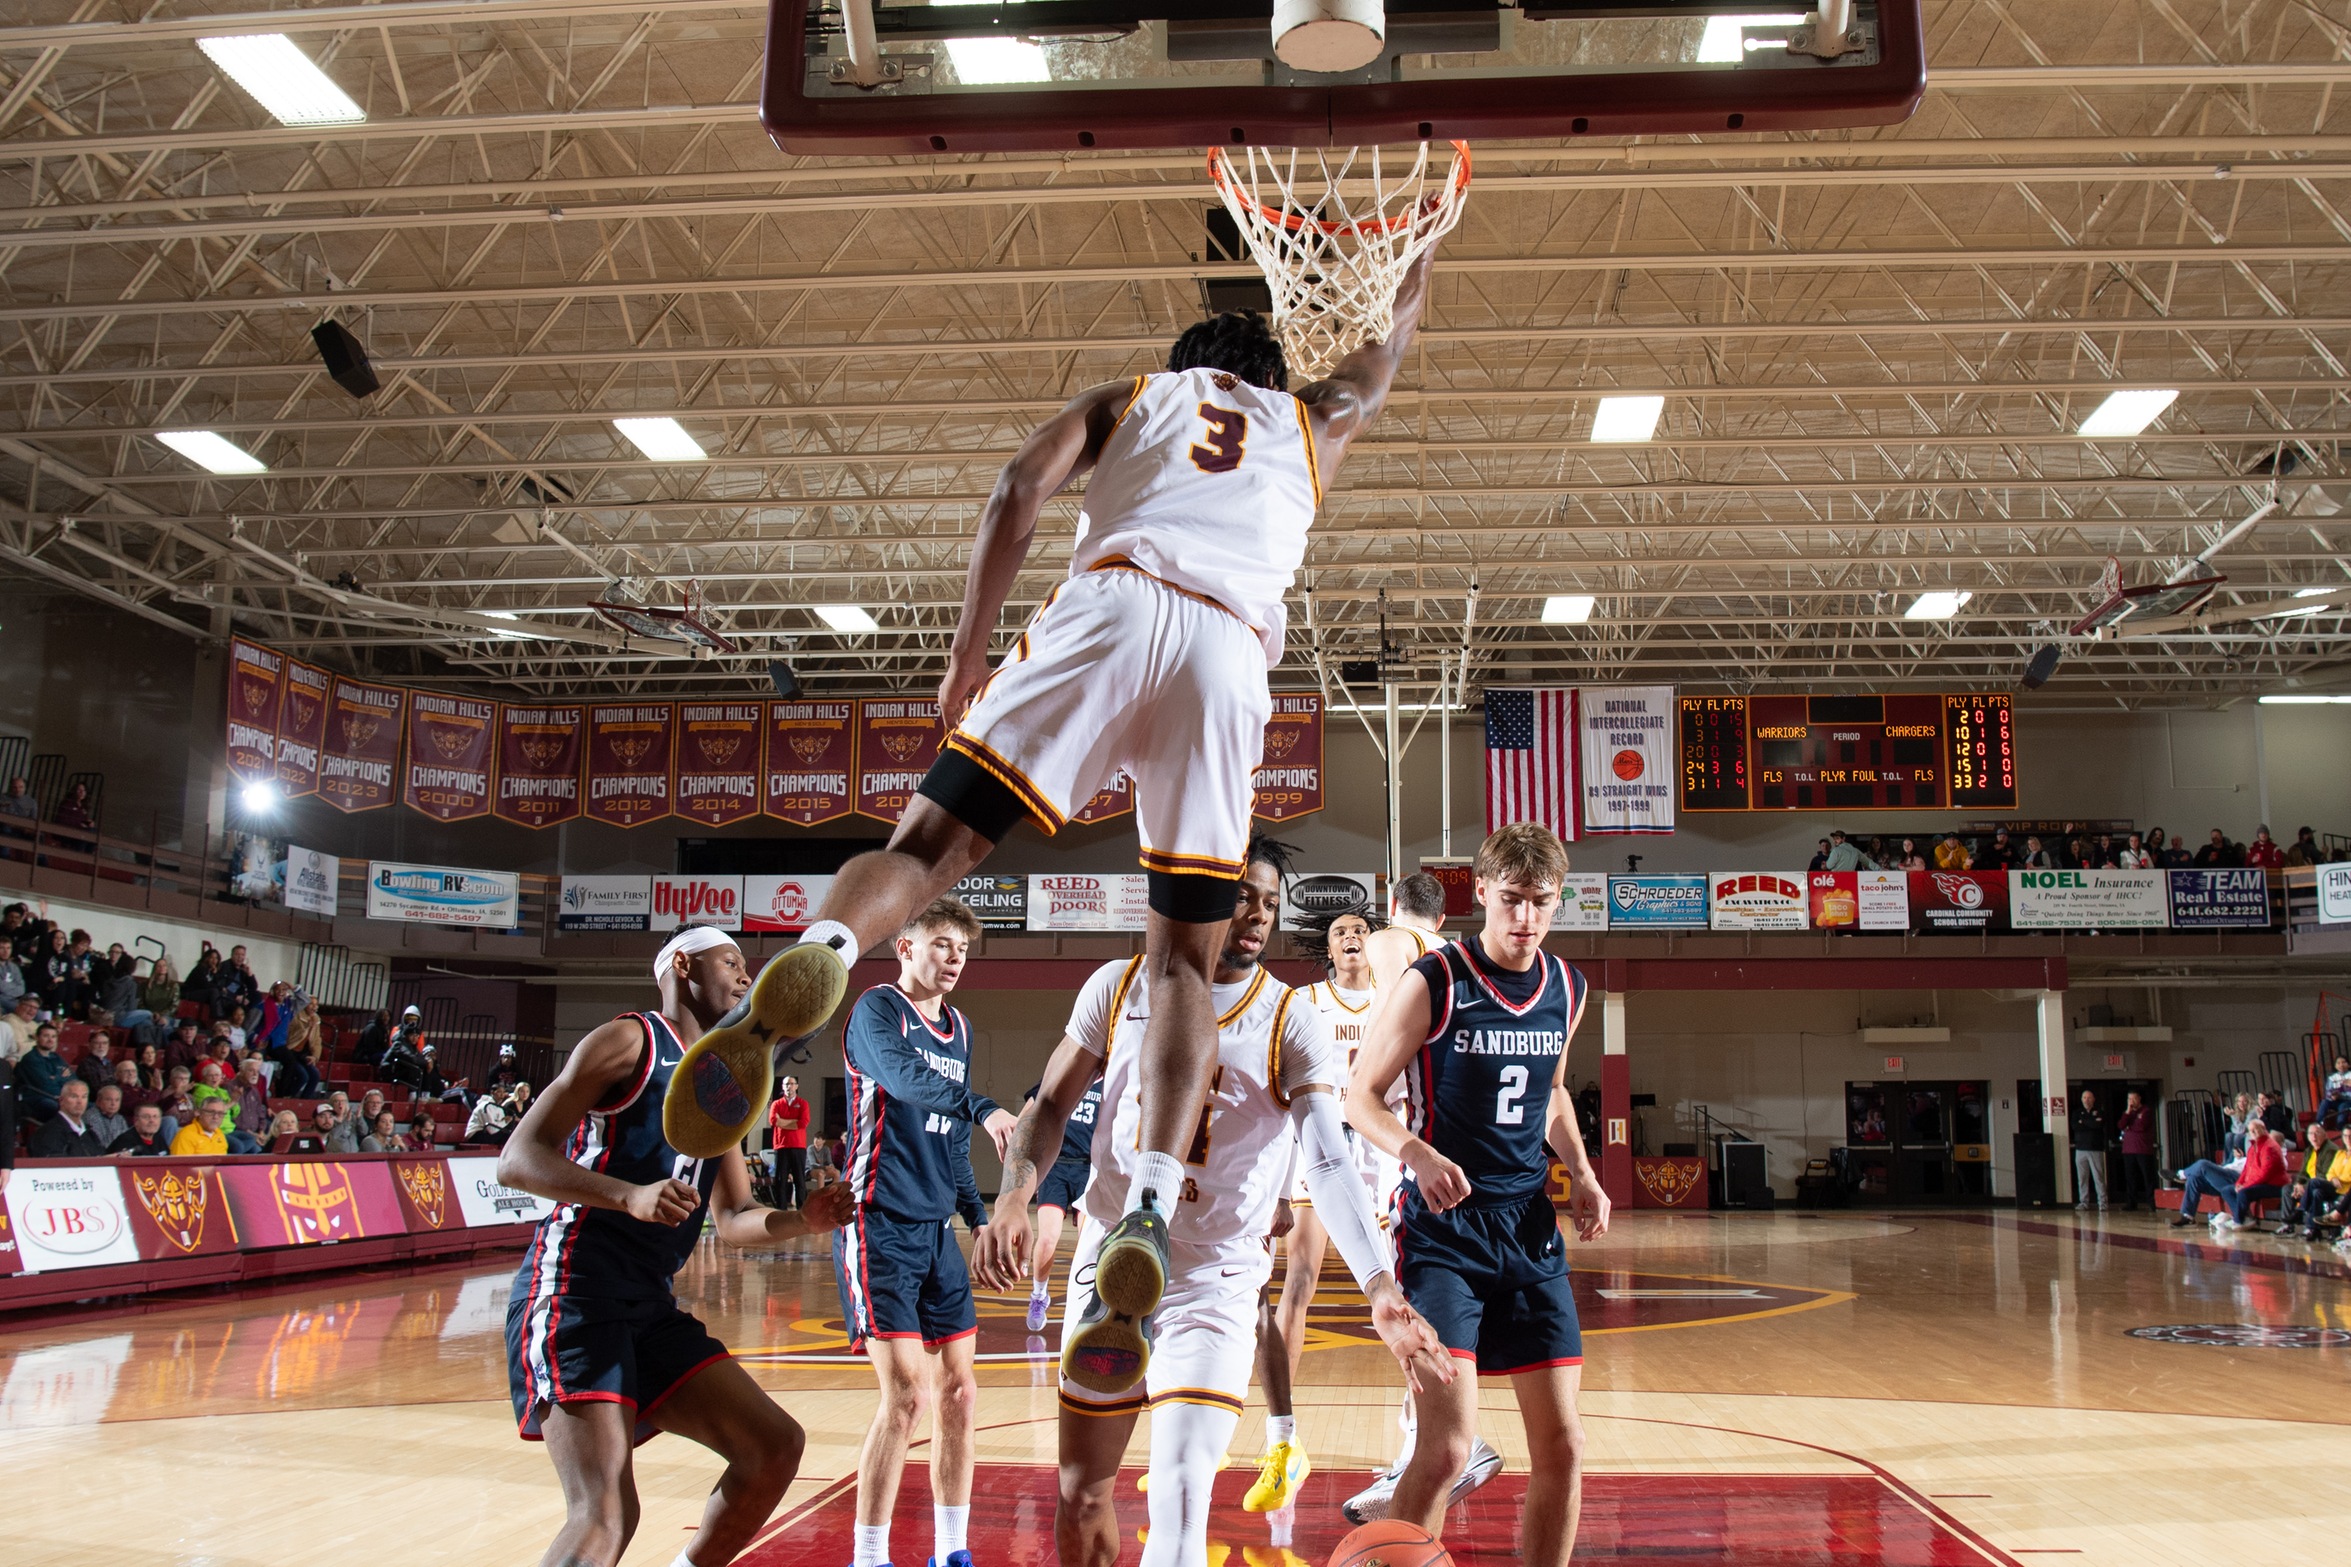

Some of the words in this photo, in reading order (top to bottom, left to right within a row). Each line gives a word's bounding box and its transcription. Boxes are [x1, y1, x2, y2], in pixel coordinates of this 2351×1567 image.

[1188, 401, 1248, 474] 3
[261, 653, 281, 673] HILLS
[337, 683, 362, 704] INDIAN
[364, 690, 399, 709] HILLS
[1948, 697, 1966, 708] PLY
[1973, 697, 1985, 708] FL
[1989, 696, 2009, 707] PTS
[416, 695, 456, 715] INDIAN
[459, 702, 492, 720] HILLS
[774, 705, 813, 720] INDIAN
[816, 704, 849, 719] HILLS
[865, 704, 905, 718] INDIAN
[908, 703, 941, 717] HILLS
[1283, 698, 1317, 713] HILLS
[1605, 700, 1647, 713] NATIONAL
[1683, 700, 1701, 711] PLY
[1707, 700, 1720, 711] FL
[1723, 700, 1744, 710] PTS
[507, 709, 547, 724] INDIAN
[549, 710, 580, 724] HILLS
[595, 708, 633, 723] INDIAN
[636, 707, 669, 722] HILLS
[684, 707, 723, 721] INDIAN
[726, 706, 758, 721] HILLS
[1695, 714, 1703, 726] 0
[1710, 714, 1718, 726] 0
[1960, 710, 1968, 724] 2
[1975, 710, 1984, 723] 0
[2000, 709, 2008, 723] 0
[1589, 716, 1664, 729] INTERCOLLEGIATE
[1696, 729, 1704, 742] 3
[1735, 729, 1743, 741] 9
[1757, 726, 1807, 739] WARRIORS
[1833, 733, 1860, 741] PERIOD
[1885, 726, 1936, 737] CHARGERS
[1956, 726, 1970, 740] 10
[2001, 726, 2009, 739] 6
[229, 723, 274, 759] CHAMPIONS
[1611, 733, 1644, 746] RECORD
[1686, 745, 1704, 758] 20
[1711, 745, 1719, 758] 0
[1736, 745, 1744, 757] 3
[1957, 742, 1970, 756] 12
[1977, 742, 1986, 755] 0
[2001, 742, 2010, 755] 6
[321, 754, 392, 787] CHAMPIONS
[1686, 762, 1704, 774] 24
[1712, 761, 1719, 774] 3
[1735, 761, 1744, 774] 6
[1957, 758, 1971, 772] 15
[2002, 758, 2011, 772] 0
[412, 766, 486, 796] CHAMPIONS
[1763, 771, 1783, 783] FLS
[1795, 773, 1816, 782] T.O.L.
[1820, 770, 1846, 782] PLYR
[1852, 770, 1878, 782] FOUL
[1883, 772, 1904, 781] T.O.L.
[1914, 769, 1934, 781] FLS
[1954, 774, 1972, 789] 33
[1978, 774, 1987, 788] 2
[2003, 774, 2012, 788] 0
[326, 780, 378, 797] 2023
[501, 777, 576, 799] CHAMPIONS
[591, 776, 666, 799] CHAMPIONS
[680, 776, 755, 798] CHAMPIONS
[770, 774, 846, 796] CHAMPIONS
[1688, 777, 1705, 791] 31
[1736, 777, 1744, 788] 4
[1588, 786, 1599, 797] 89
[1602, 785, 1643, 798] STRAIGHT
[1645, 785, 1668, 798] WINS
[420, 790, 474, 807] 2000
[692, 799, 740, 810] 2014
[784, 797, 831, 809] 2015
[518, 801, 560, 813] 2011
[604, 800, 651, 811] 2012
[1608, 801, 1650, 812] 1997-1999
[2005, 822, 2031, 831] VIP
[381, 869, 440, 892] Bowling
[443, 875, 504, 896] RVs.com
[1040, 877, 1100, 890] REED
[1812, 874, 1836, 888] olé
[2021, 872, 2088, 889] NOEL
[2094, 877, 2153, 888] Insurance
[2202, 871, 2261, 890] TEAM
[1305, 885, 1350, 893] DOWNTOWN
[1619, 886, 1703, 899] SCHROEDER
[1716, 875, 1801, 901] REED
[1881, 884, 1905, 892] john's
[588, 891, 620, 899] FAMILY
[623, 891, 649, 899] FIRST
[959, 894, 1022, 907] CEILING
[1048, 890, 1106, 900] OVERHEAD
[1305, 896, 1350, 906] FITNESS
[2070, 893, 2101, 901] Sponsor
[2104, 892, 2112, 900] of
[2175, 891, 2210, 903] Real
[2216, 891, 2263, 903] Estate
[399, 903, 428, 911] Sycamore
[772, 896, 808, 911] OTTUMWA
[1049, 901, 1107, 915] DOORS
[1636, 899, 1678, 912] Graphics
[405, 910, 481, 922] 641-682-5497
[2177, 906, 2263, 916] 641.682.2221
[1453, 1029, 1564, 1056] SANDBURG
[1888, 1058, 1900, 1068] EXIT
[2108, 1056, 2120, 1066] EXIT
[1495, 1065, 1530, 1124] 2
[1070, 1102, 1096, 1124] 23
[32, 1179, 78, 1191] Powered
[81, 1178, 94, 1192] by
[497, 1200, 510, 1208] ALE
[511, 1198, 534, 1207] HOUSE
[42, 1206, 105, 1236] JBS
